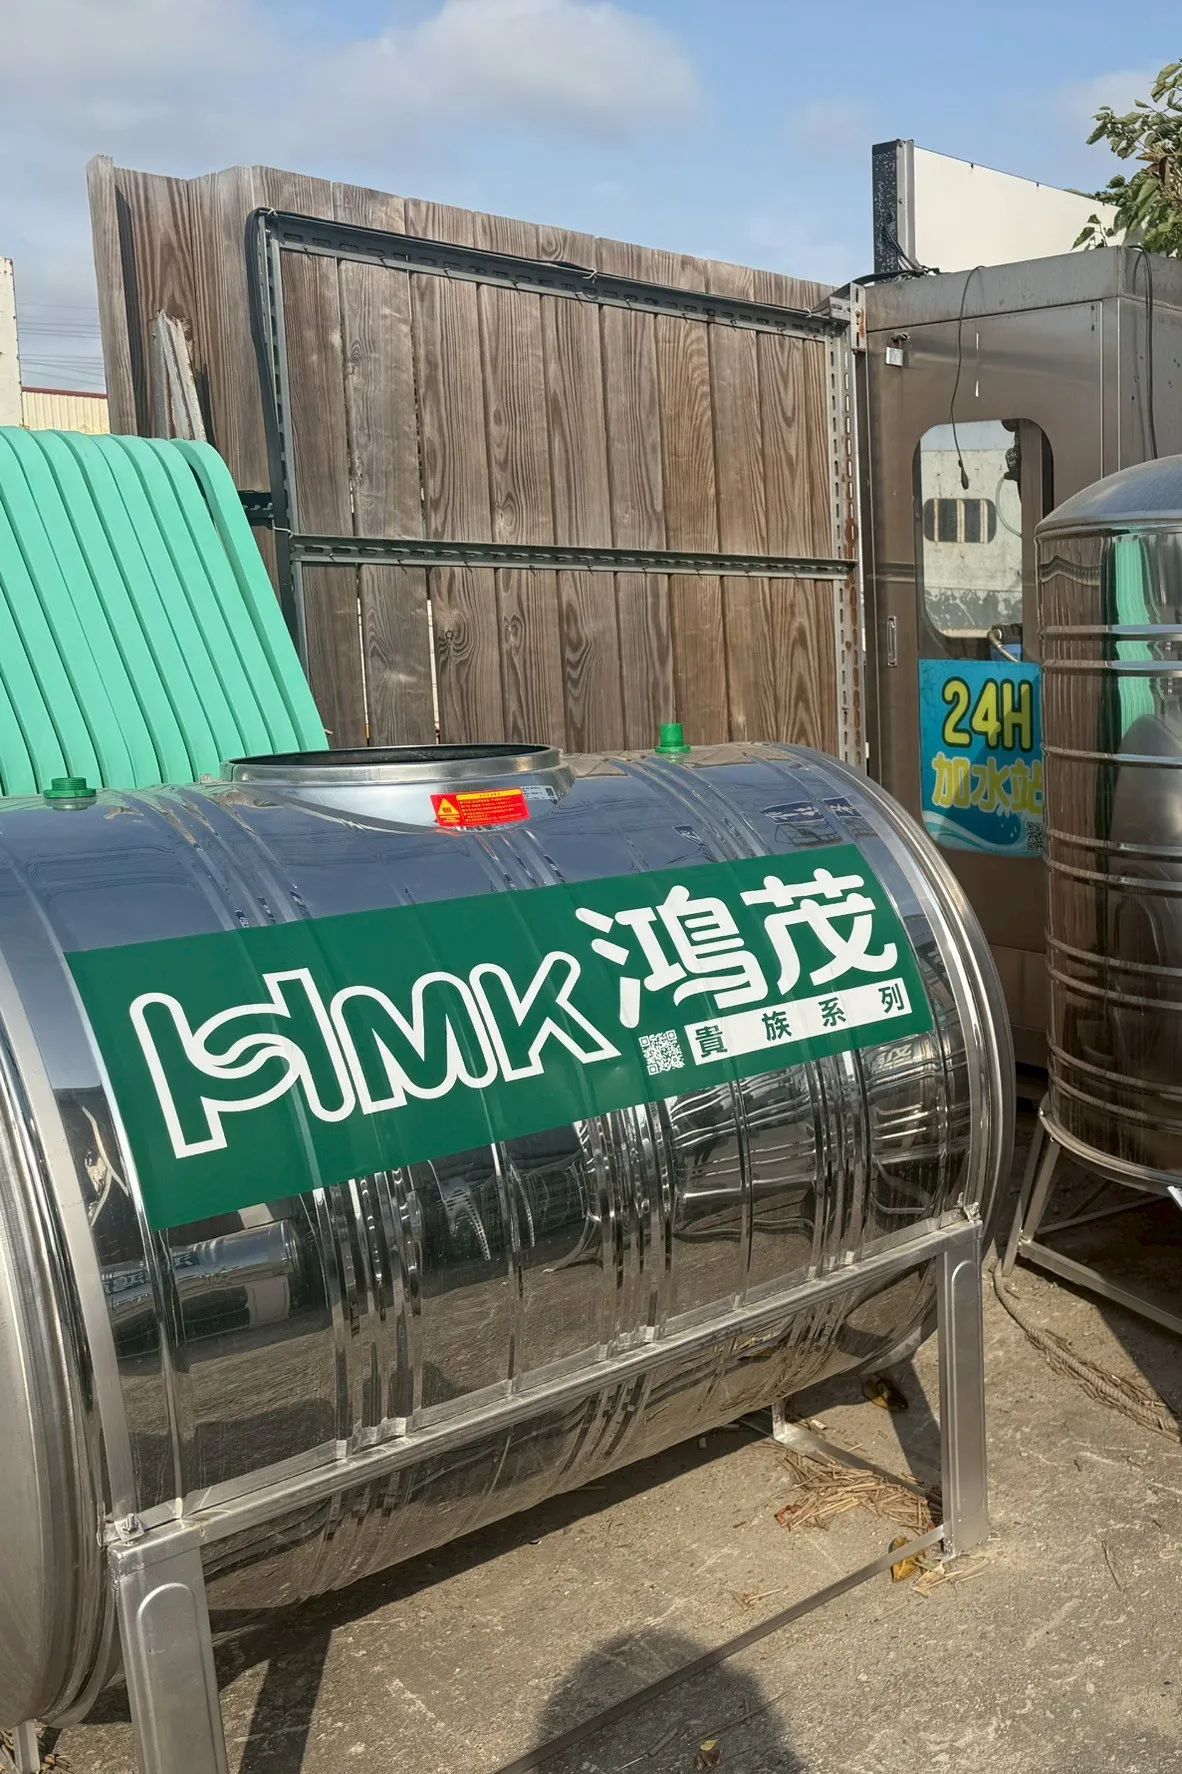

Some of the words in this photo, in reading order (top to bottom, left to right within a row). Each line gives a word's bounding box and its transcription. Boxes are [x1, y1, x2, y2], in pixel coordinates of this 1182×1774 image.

[942, 676, 1033, 752] 24H
[931, 751, 1043, 814] 加水站
[129, 951, 621, 1159] HMK
[576, 867, 898, 1028] 鴻茂
[695, 983, 905, 1058] 貴族系列
